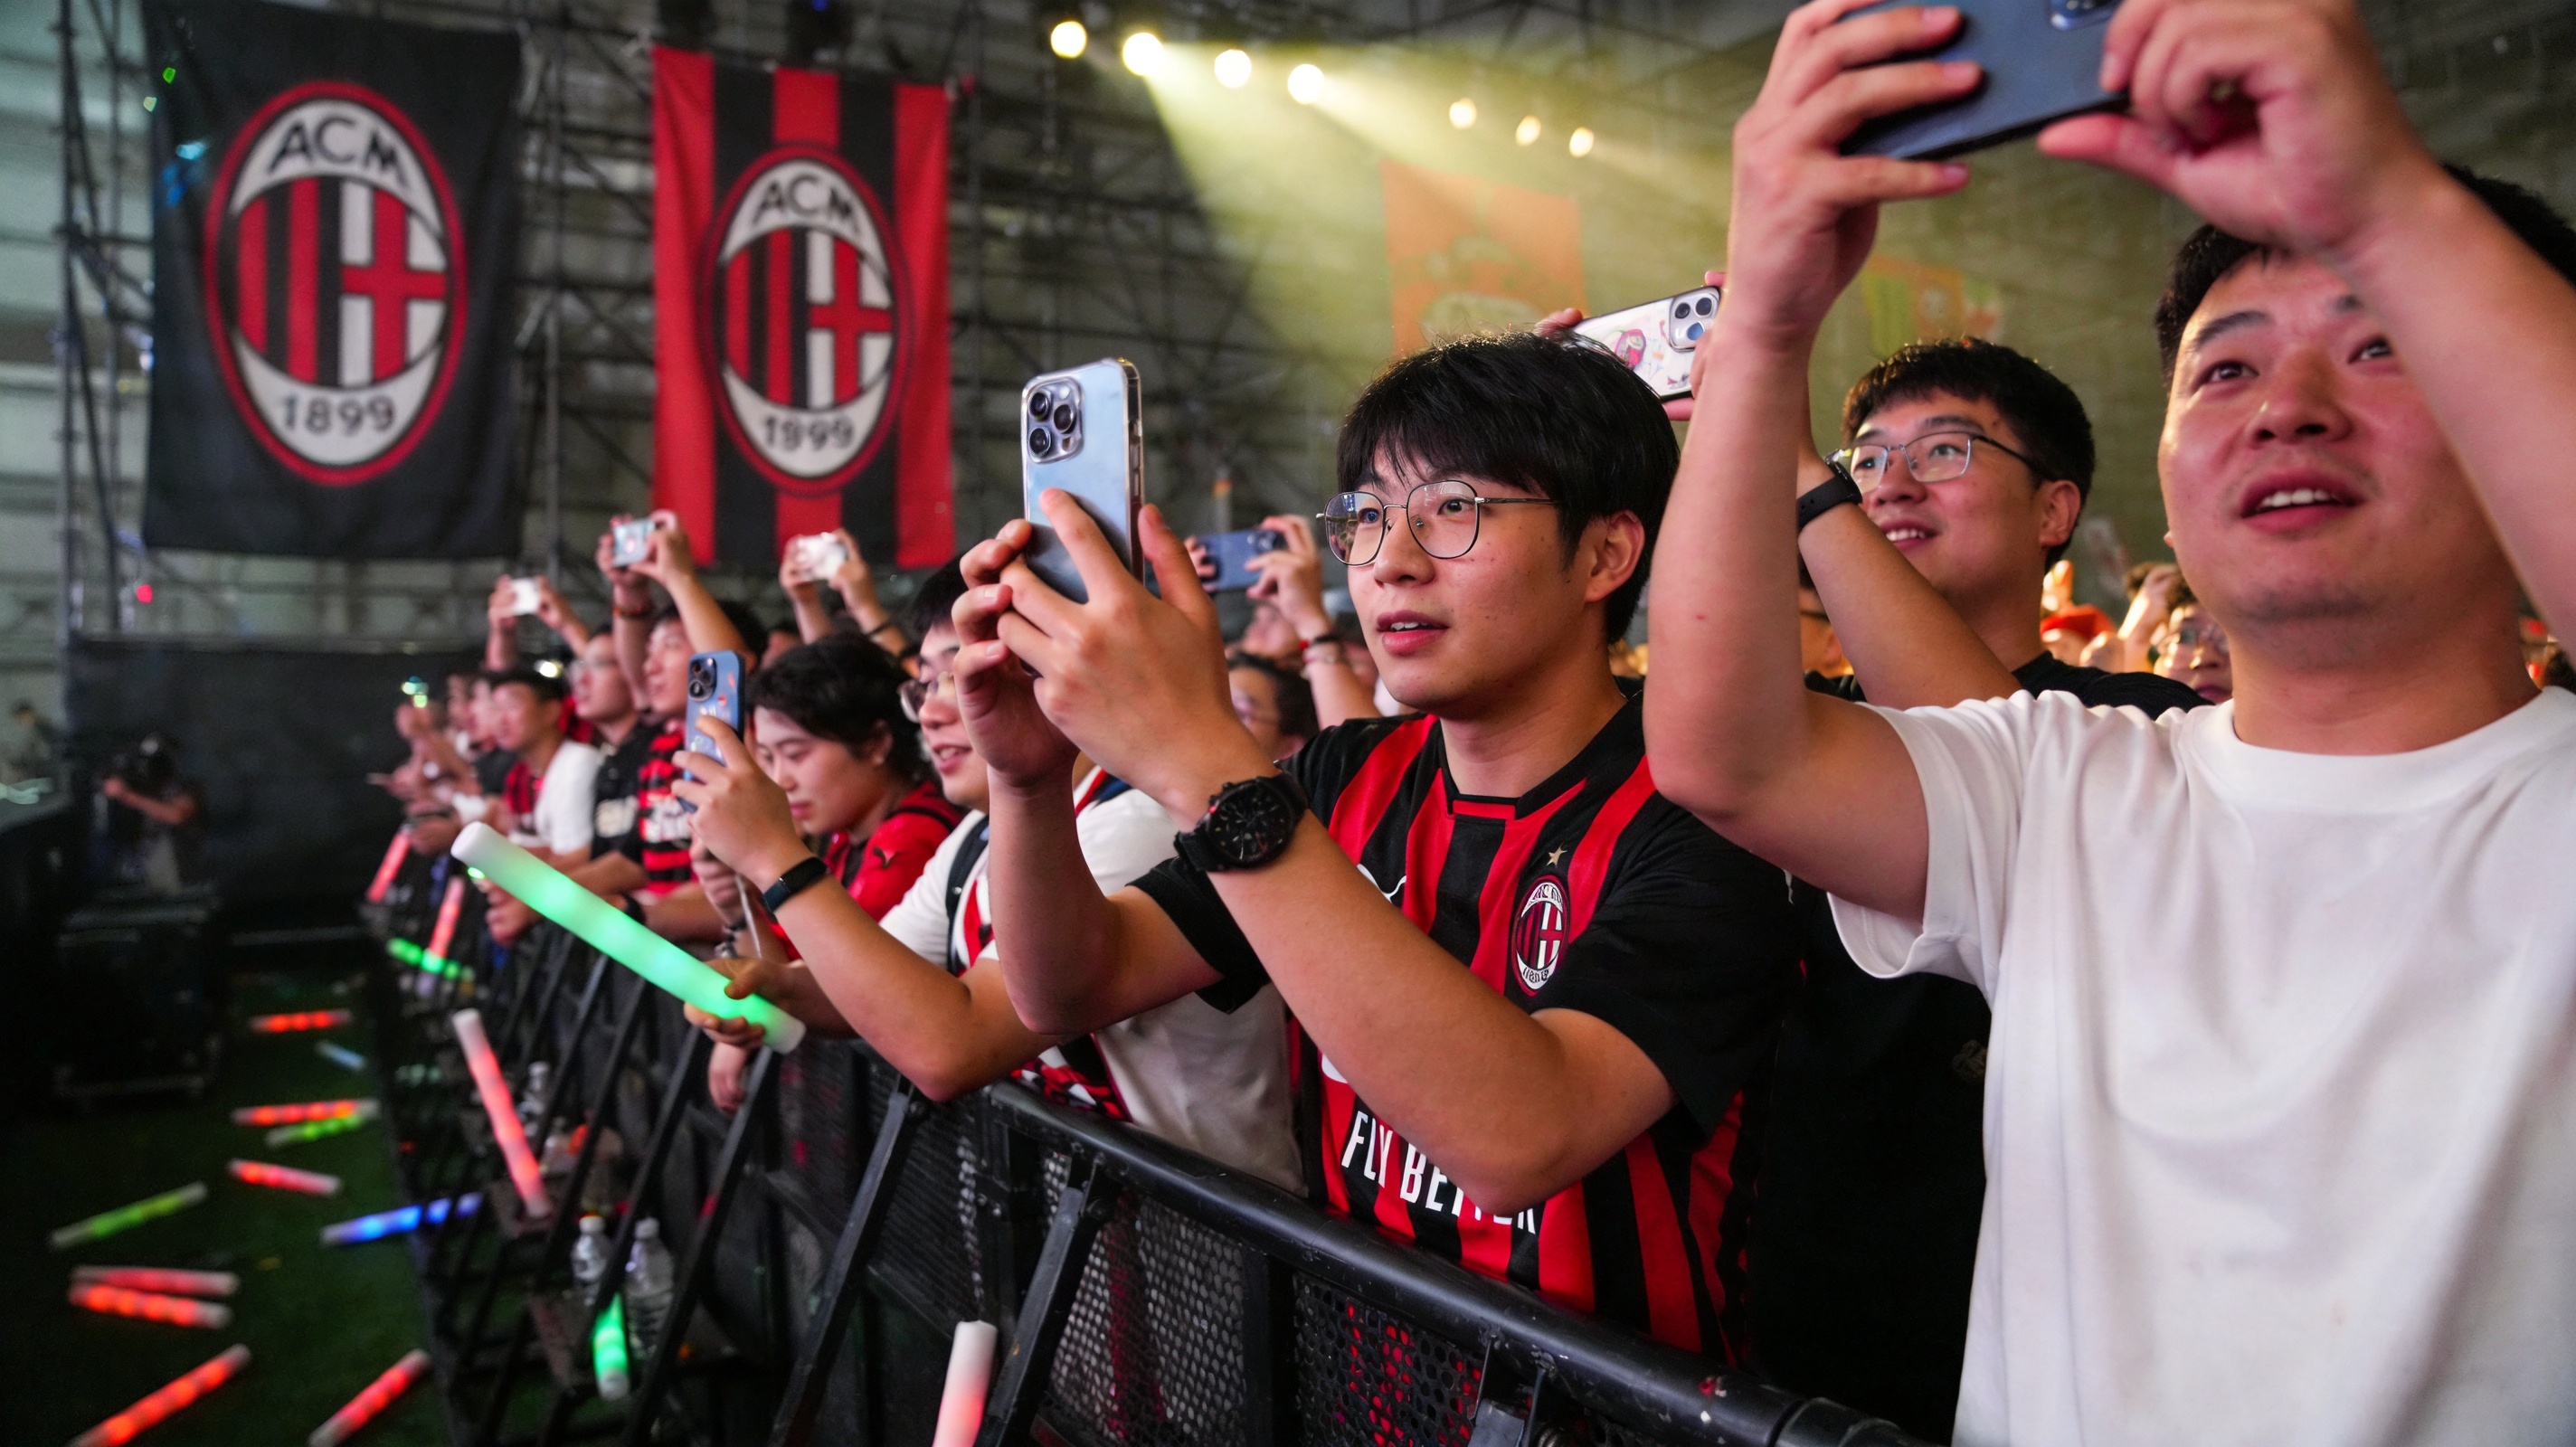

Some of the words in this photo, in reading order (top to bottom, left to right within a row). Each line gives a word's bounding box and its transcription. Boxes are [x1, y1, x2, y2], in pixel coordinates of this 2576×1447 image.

[269, 116, 408, 187] ACM
[752, 175, 861, 233] ACM
[284, 394, 395, 437] 1899
[1341, 1111, 1394, 1188] FLY
